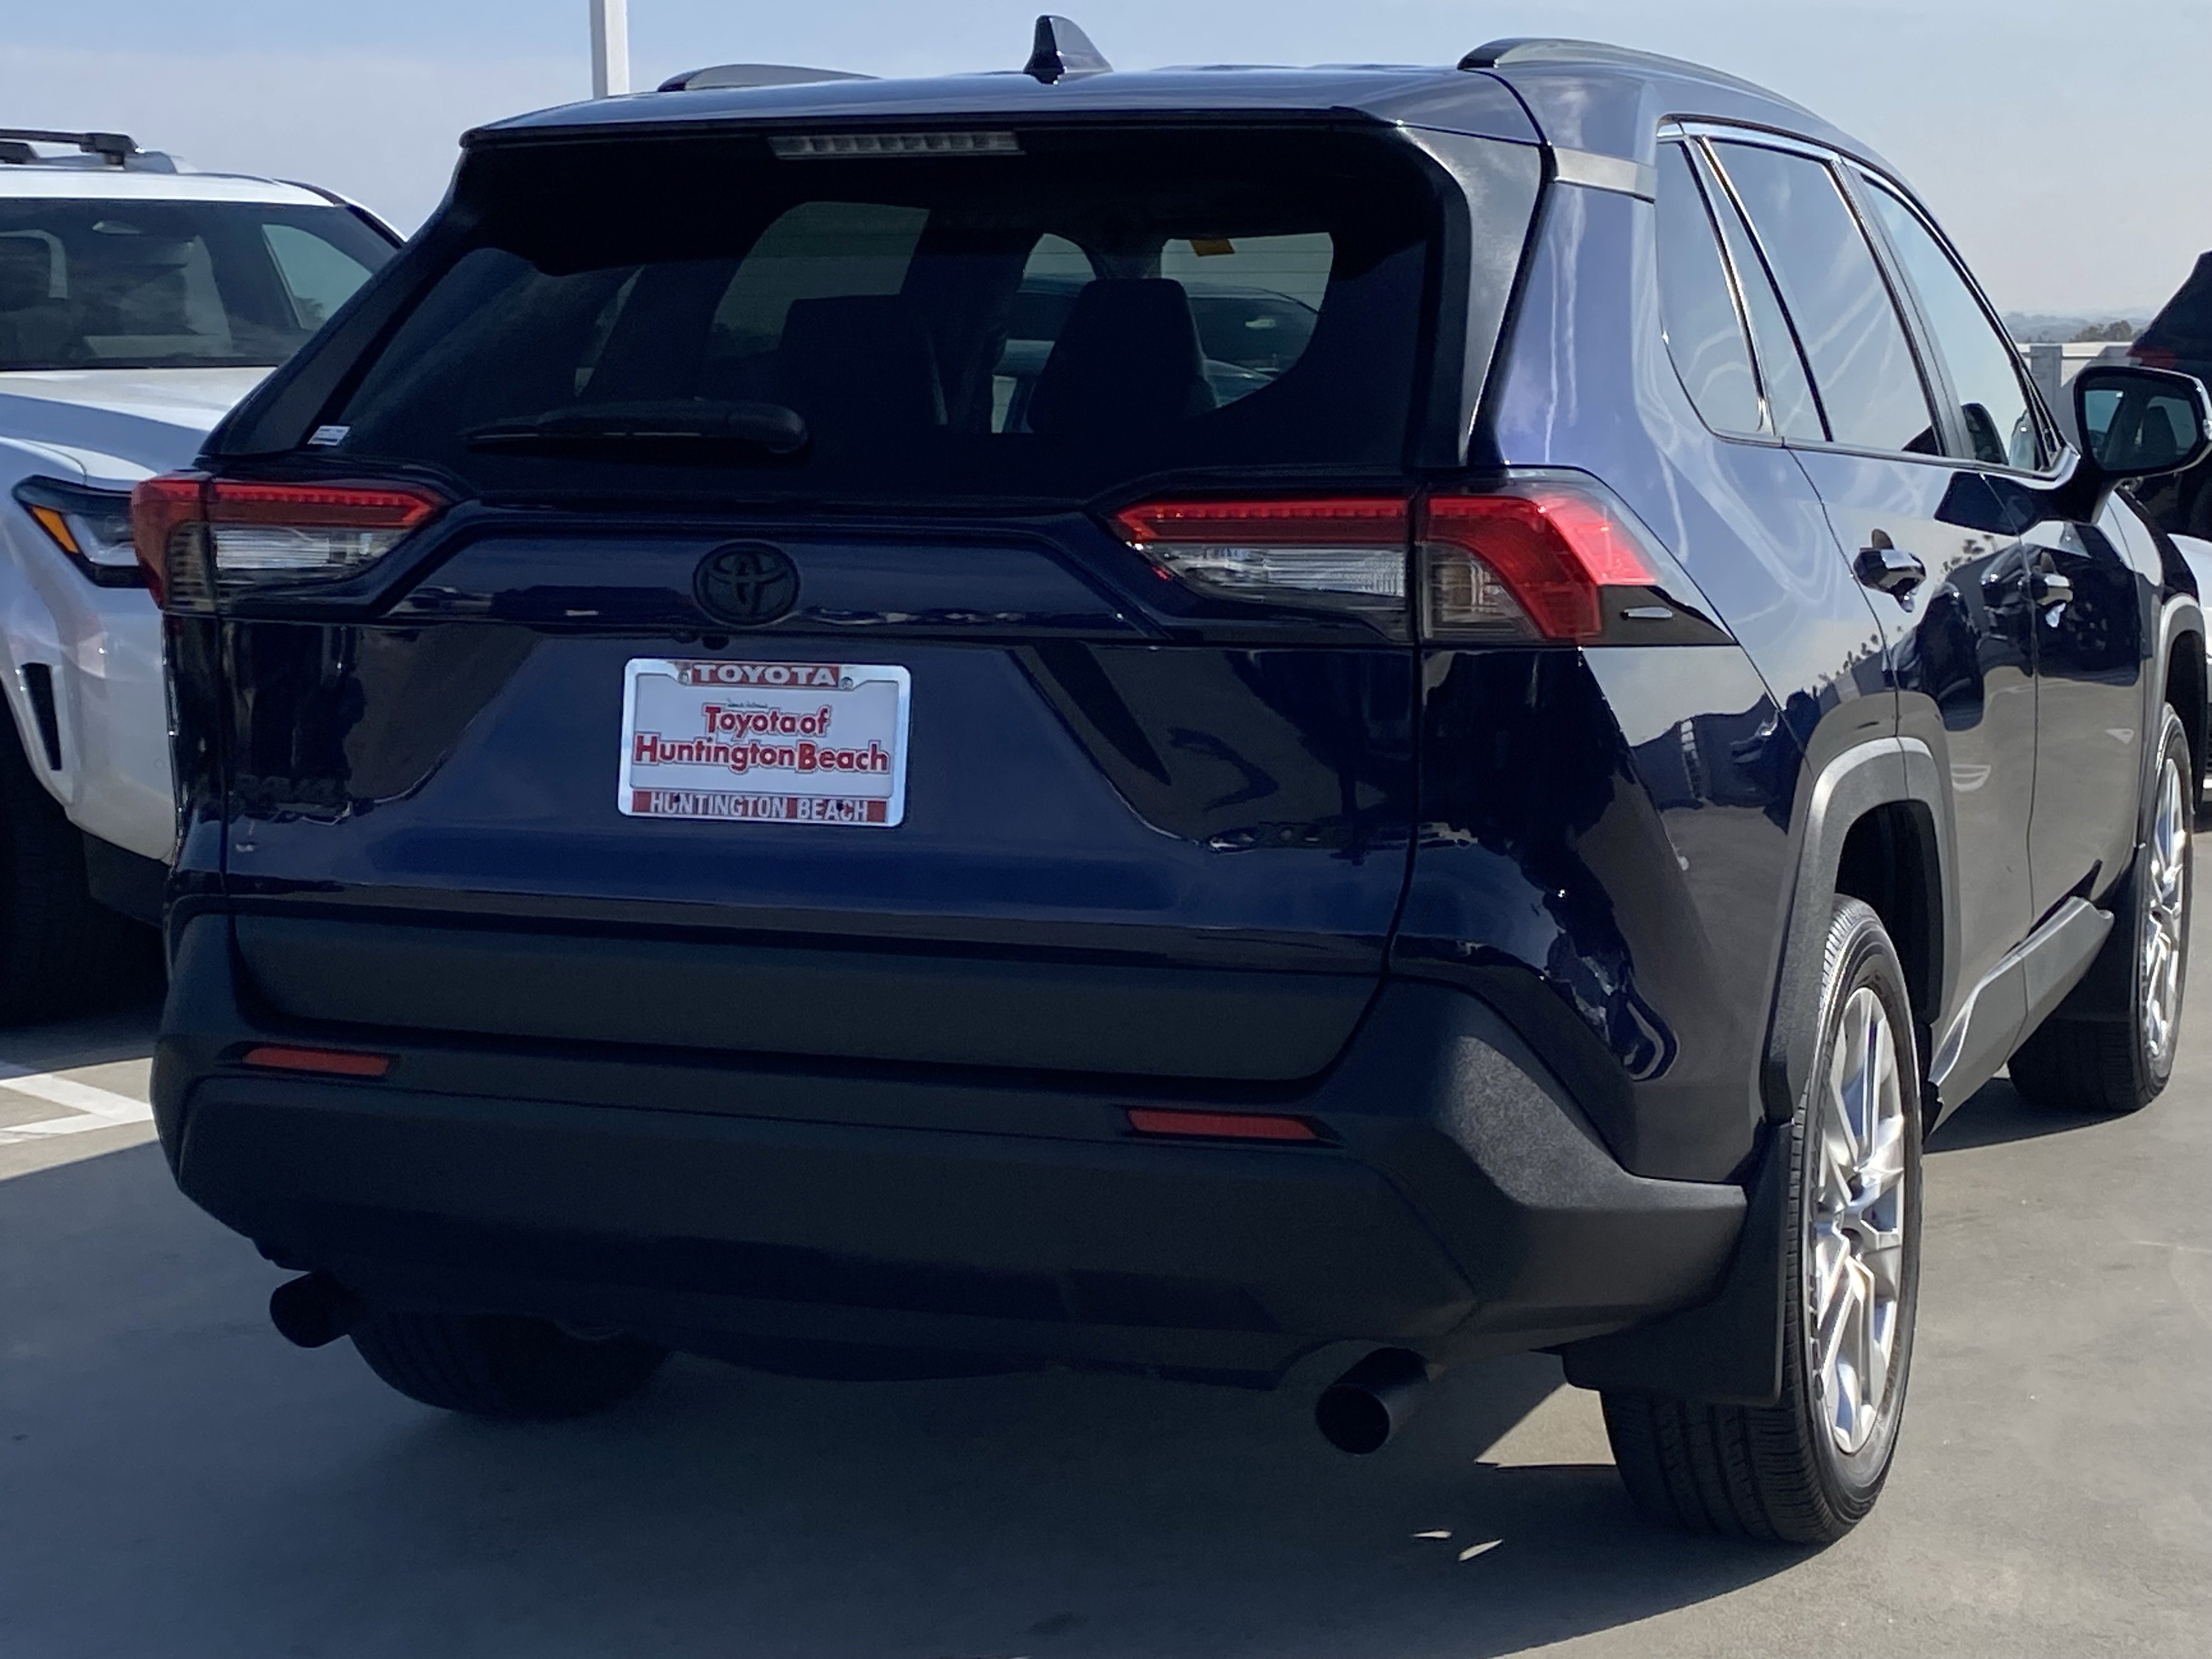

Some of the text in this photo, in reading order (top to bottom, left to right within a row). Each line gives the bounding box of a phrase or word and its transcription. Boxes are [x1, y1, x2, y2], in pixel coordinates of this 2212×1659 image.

[693, 663, 838, 686] TOYOTA
[705, 706, 830, 738] Toyota of
[634, 735, 889, 771] Huntington Beach
[651, 792, 868, 822] HUNTINGTON BEACH
